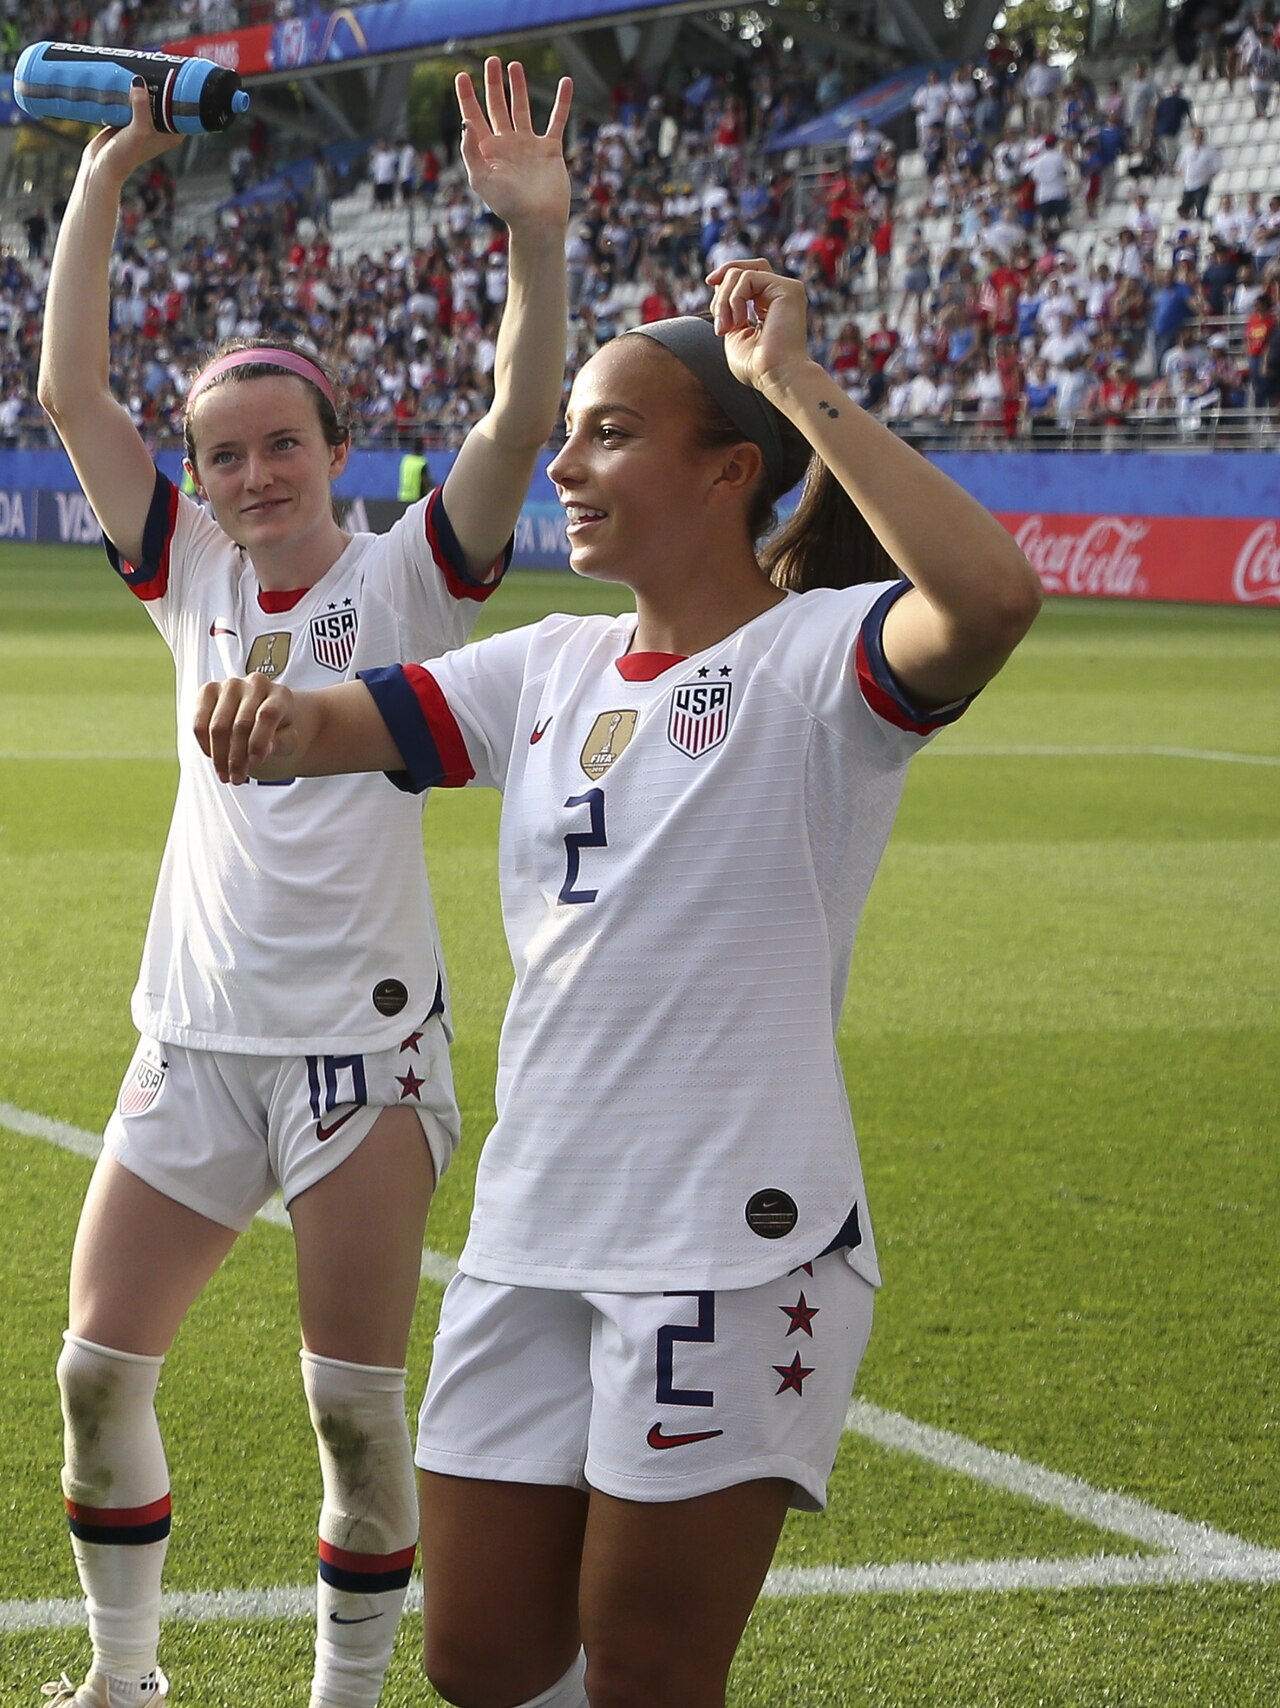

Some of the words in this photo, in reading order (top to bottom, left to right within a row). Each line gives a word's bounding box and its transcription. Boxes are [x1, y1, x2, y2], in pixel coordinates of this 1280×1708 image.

[55, 491, 104, 543] VIS
[314, 613, 354, 639] USA
[676, 687, 726, 716] USA
[590, 754, 613, 763] FIFA
[557, 787, 608, 904] 2
[137, 1063, 160, 1089] USA
[655, 1290, 715, 1407] 2
